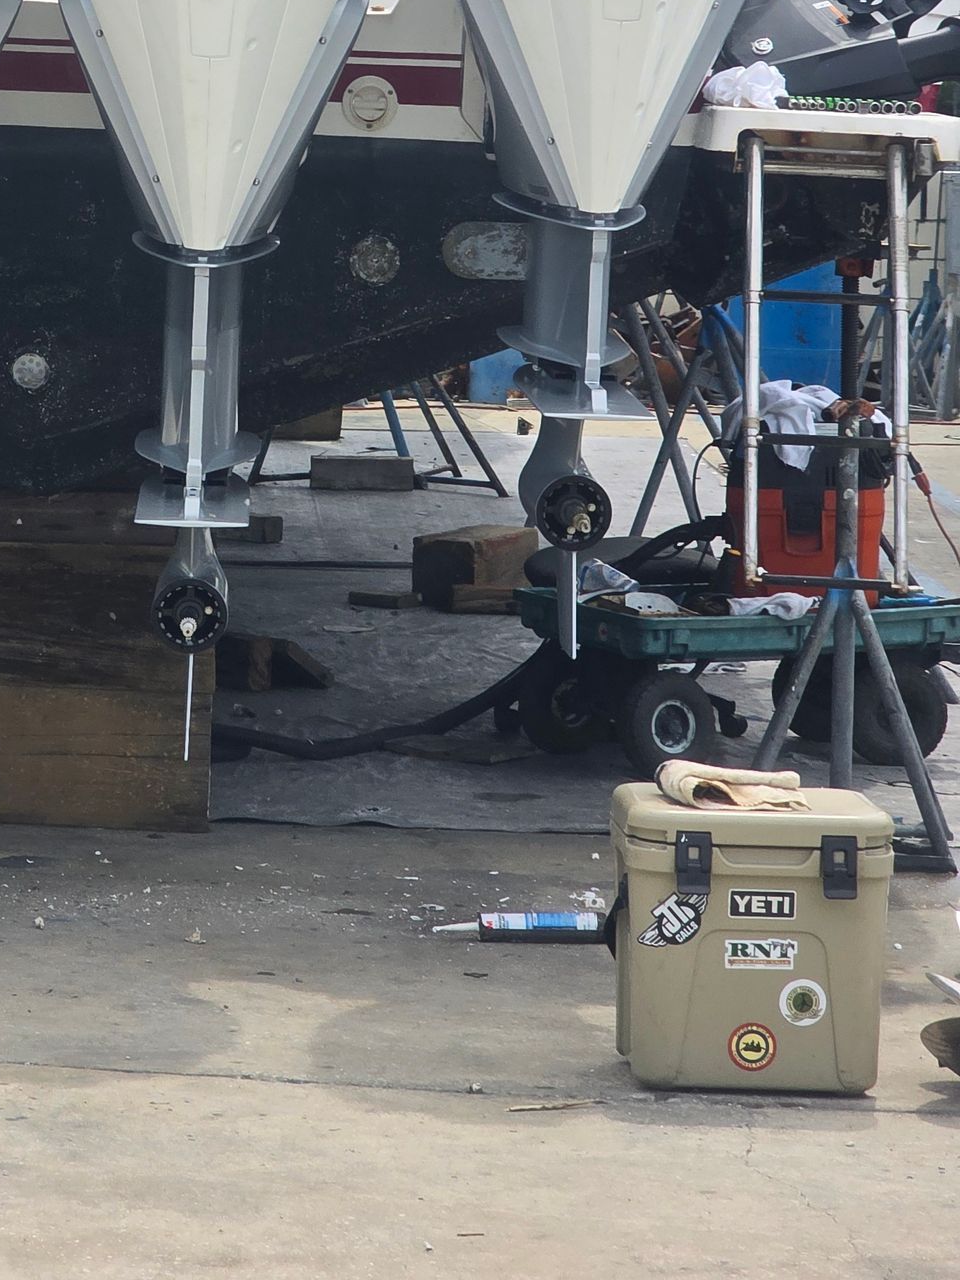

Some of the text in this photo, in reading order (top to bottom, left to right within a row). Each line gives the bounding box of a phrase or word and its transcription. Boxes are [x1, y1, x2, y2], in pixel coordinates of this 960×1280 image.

[733, 895, 790, 914] YETI
[675, 921, 699, 943] CALLS
[728, 941, 795, 959] RNT
